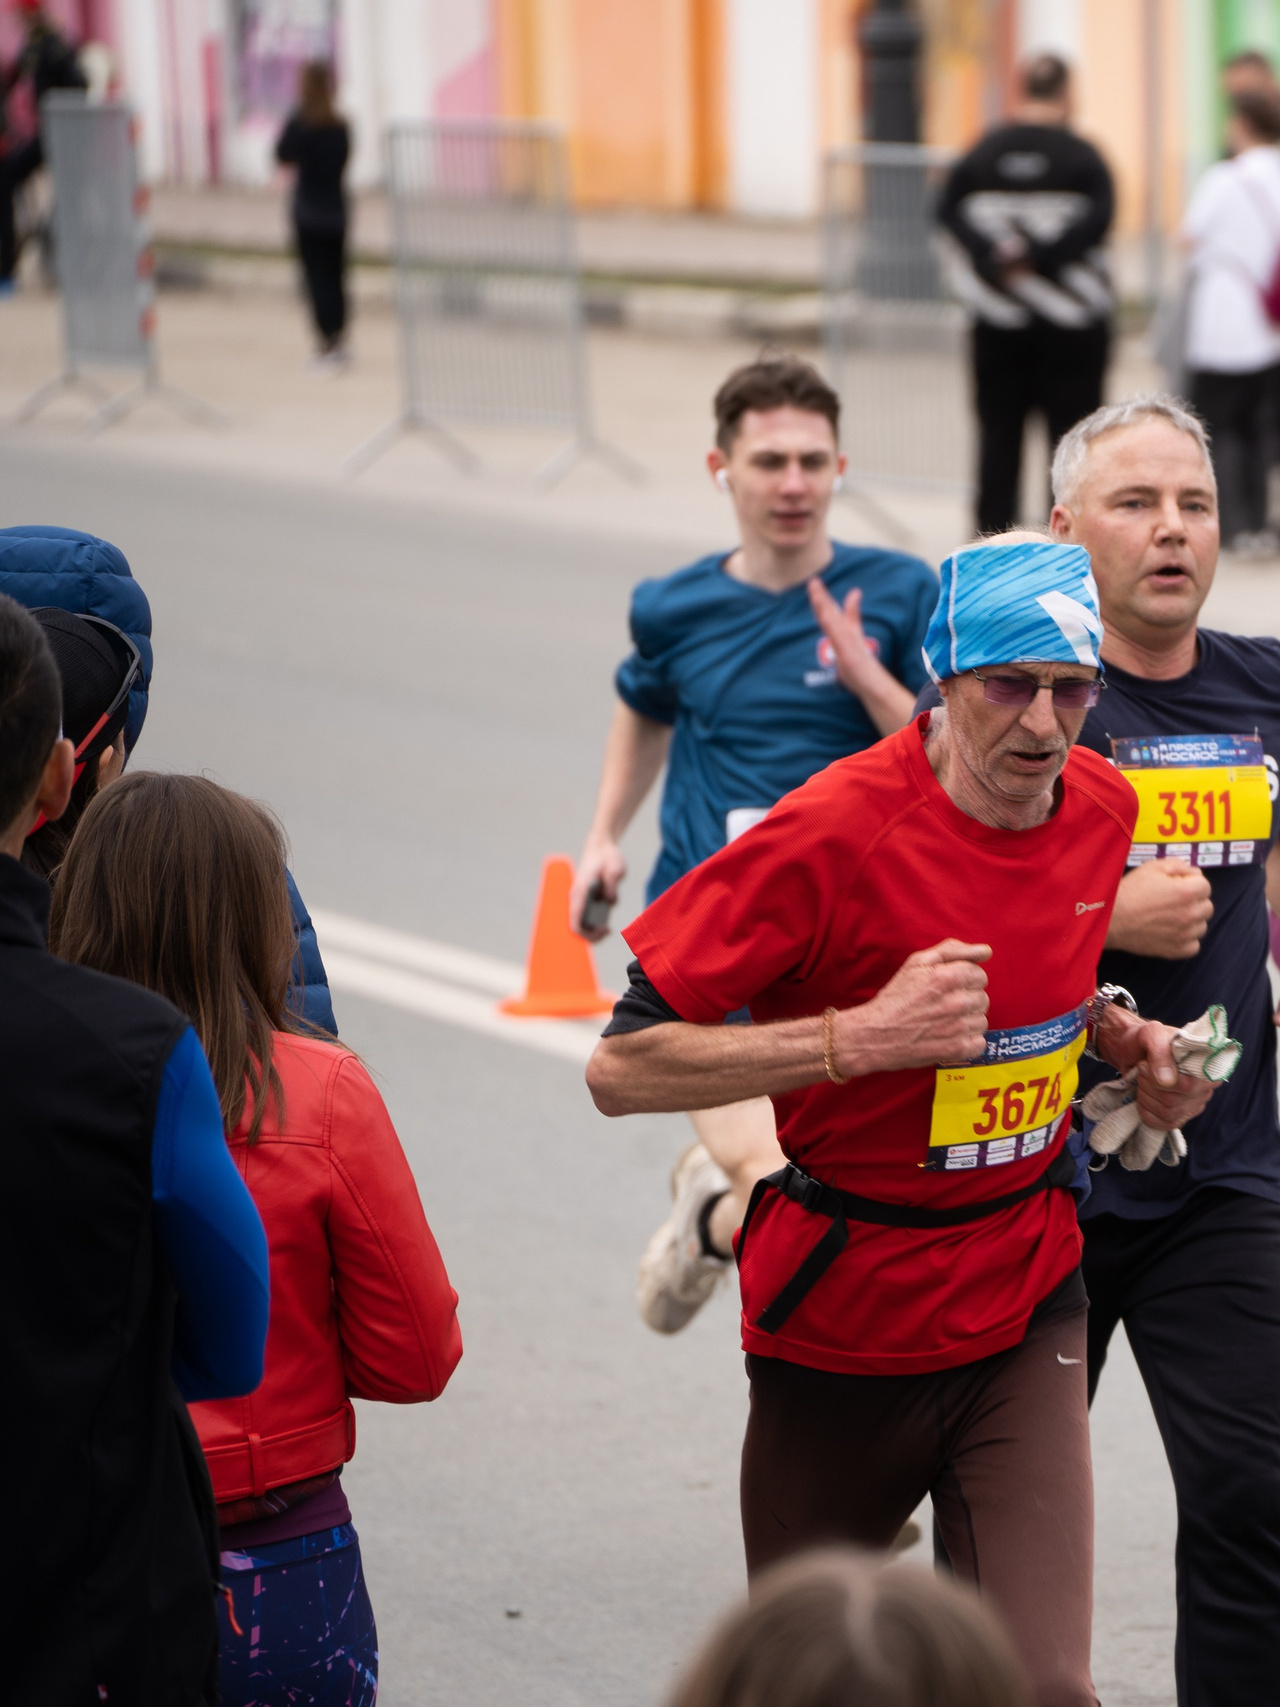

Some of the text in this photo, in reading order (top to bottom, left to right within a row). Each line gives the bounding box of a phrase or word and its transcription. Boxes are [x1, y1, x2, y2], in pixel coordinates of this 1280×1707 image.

[1159, 751, 1220, 762] КОСМОС
[1168, 742, 1219, 751] ПРОСТО
[1157, 790, 1232, 837] 3311
[997, 1033, 1063, 1056] КОСМОС
[1010, 1024, 1063, 1044] ПРОСТО
[973, 1072, 1062, 1136] 3674
